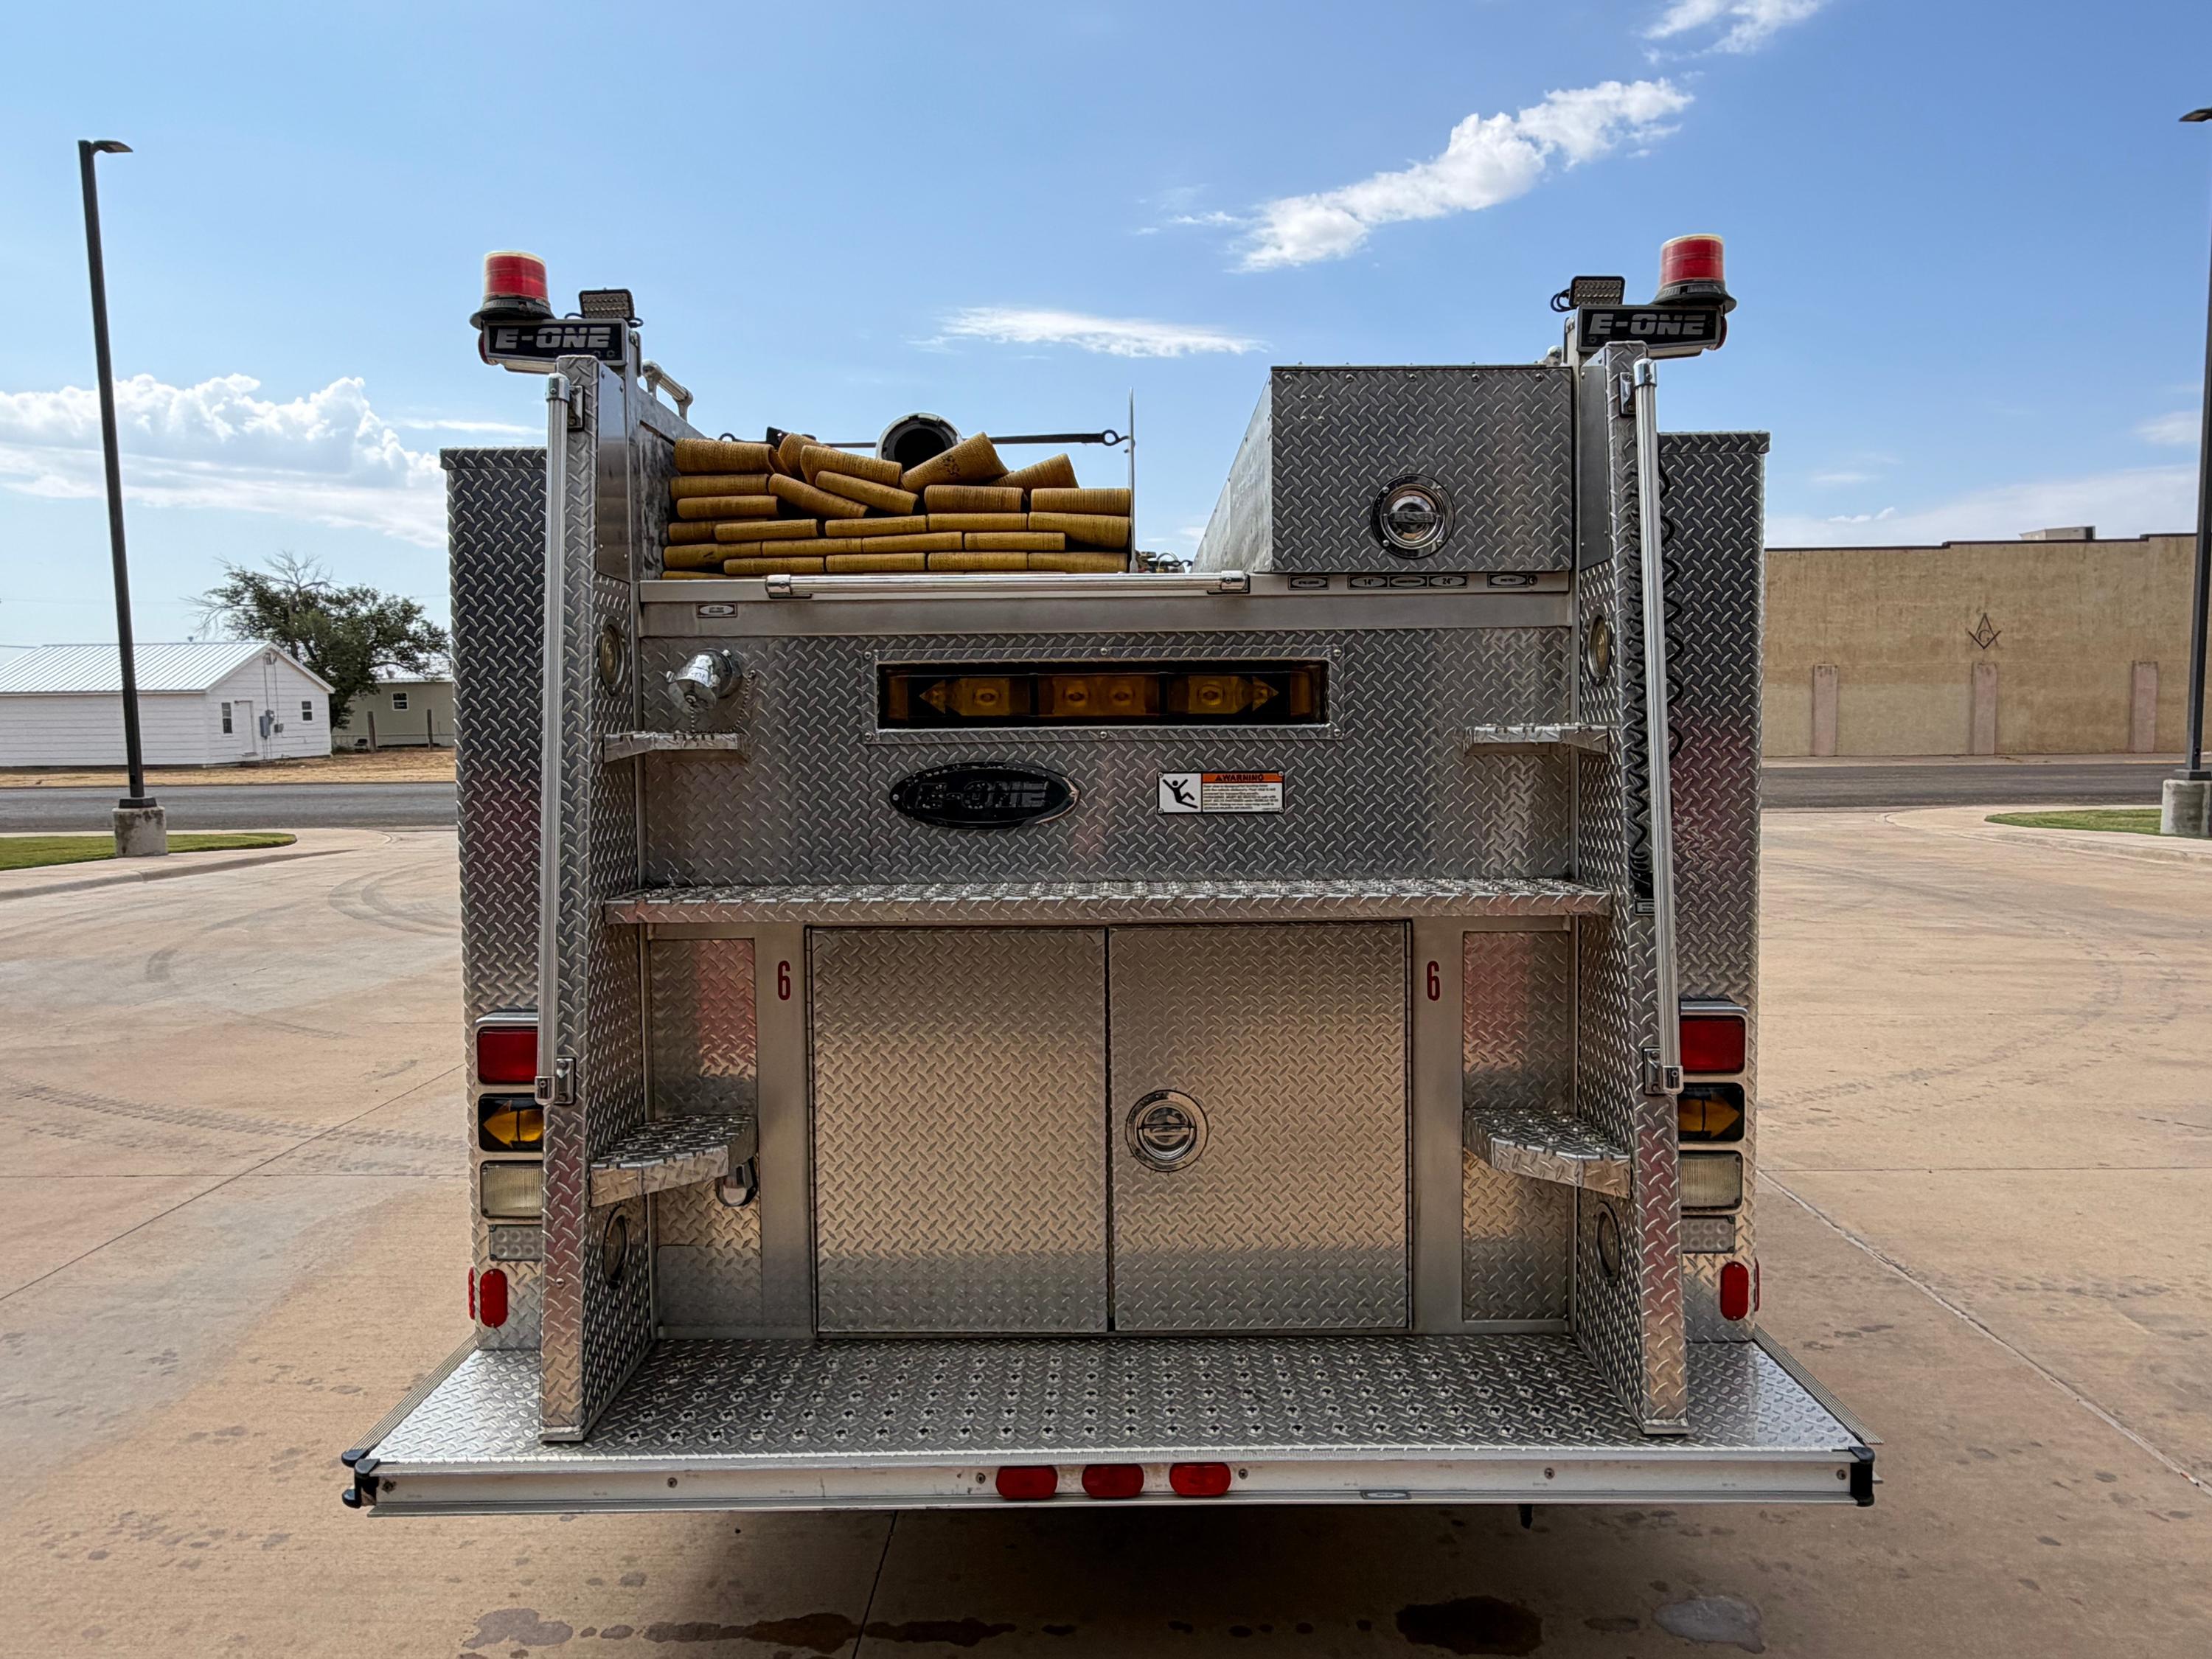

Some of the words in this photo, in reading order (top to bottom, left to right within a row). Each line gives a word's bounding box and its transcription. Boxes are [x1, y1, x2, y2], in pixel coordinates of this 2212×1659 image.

[1588, 313, 1706, 335] E-ONE
[495, 327, 611, 349] E-ONE
[1222, 773, 1265, 782] WARNING
[777, 960, 790, 1001] 6
[1427, 960, 1440, 1001] 6
